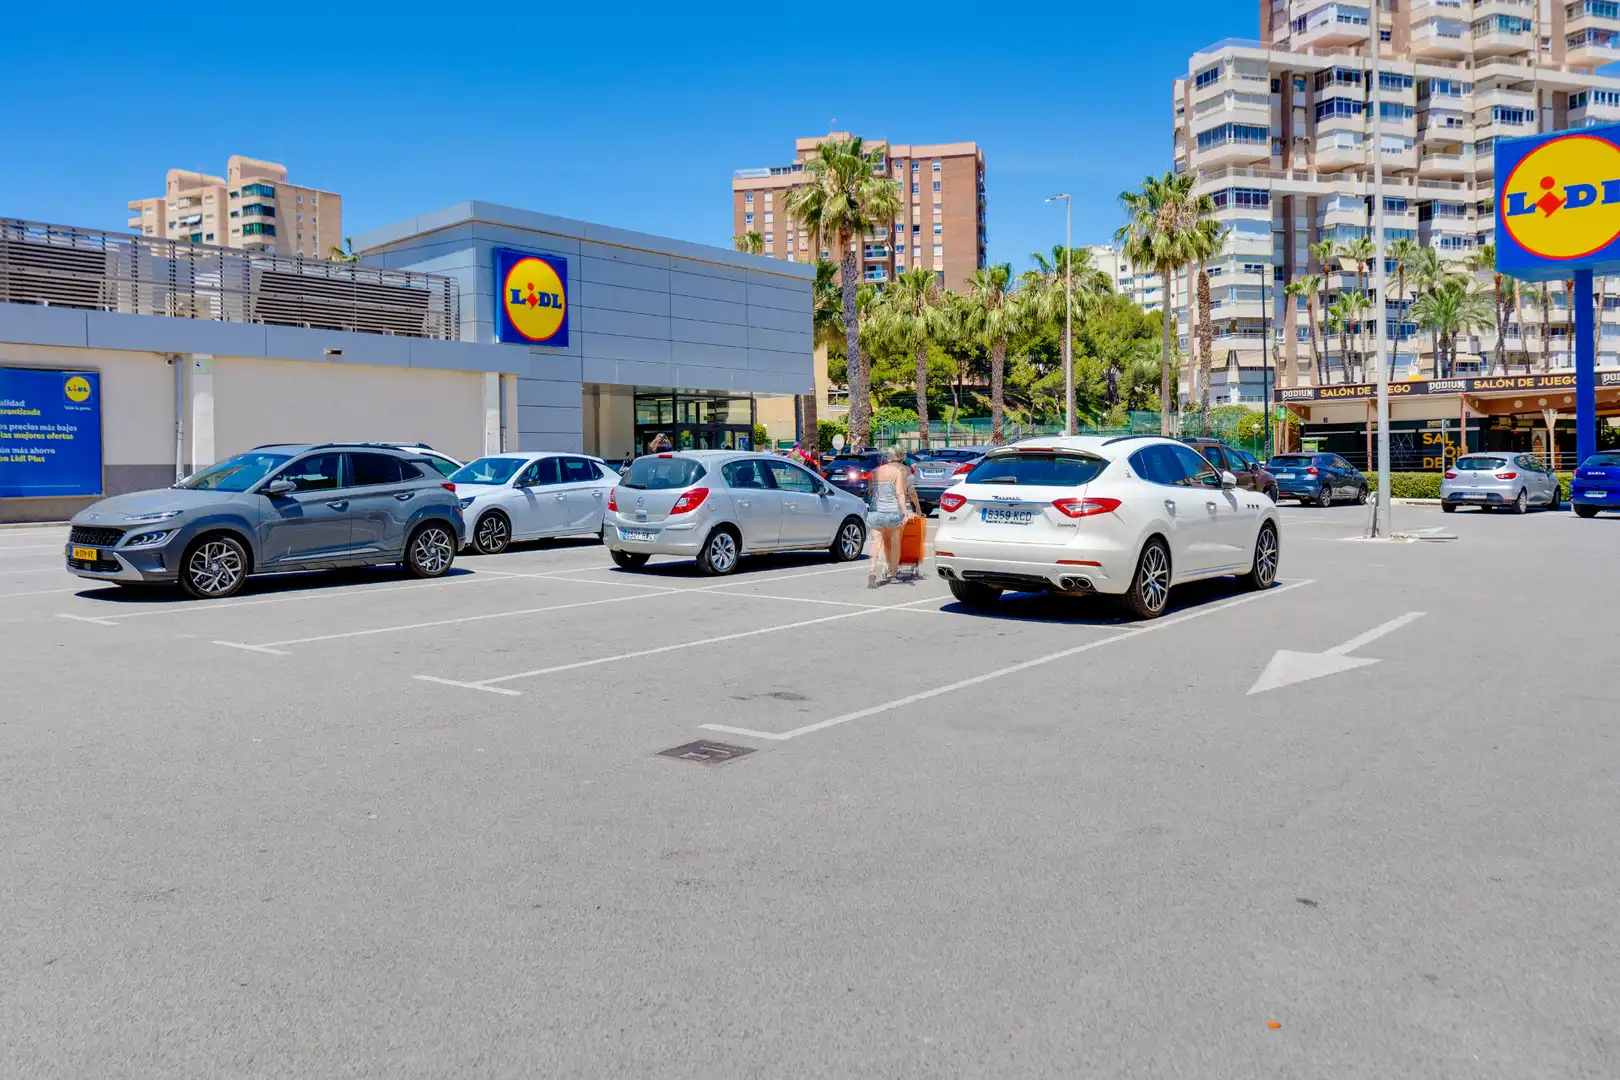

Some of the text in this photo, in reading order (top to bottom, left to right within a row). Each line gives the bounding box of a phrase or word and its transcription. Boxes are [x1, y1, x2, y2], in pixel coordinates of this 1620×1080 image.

[510, 282, 562, 310] LIDL
[1428, 380, 1466, 393] PODIUM
[1473, 378, 1514, 390] SALÓN
[1517, 378, 1535, 387] DE
[1282, 389, 1314, 400] PODIUM
[1320, 386, 1355, 398] SALÓN
[1357, 386, 1371, 395] DE
[9, 423, 39, 432] precios
[57, 424, 77, 433] bajos
[14, 432, 45, 440] mejores
[47, 432, 74, 440] ofertas
[1422, 432, 1454, 445] SAL
[1013, 511, 1032, 521] KCD
